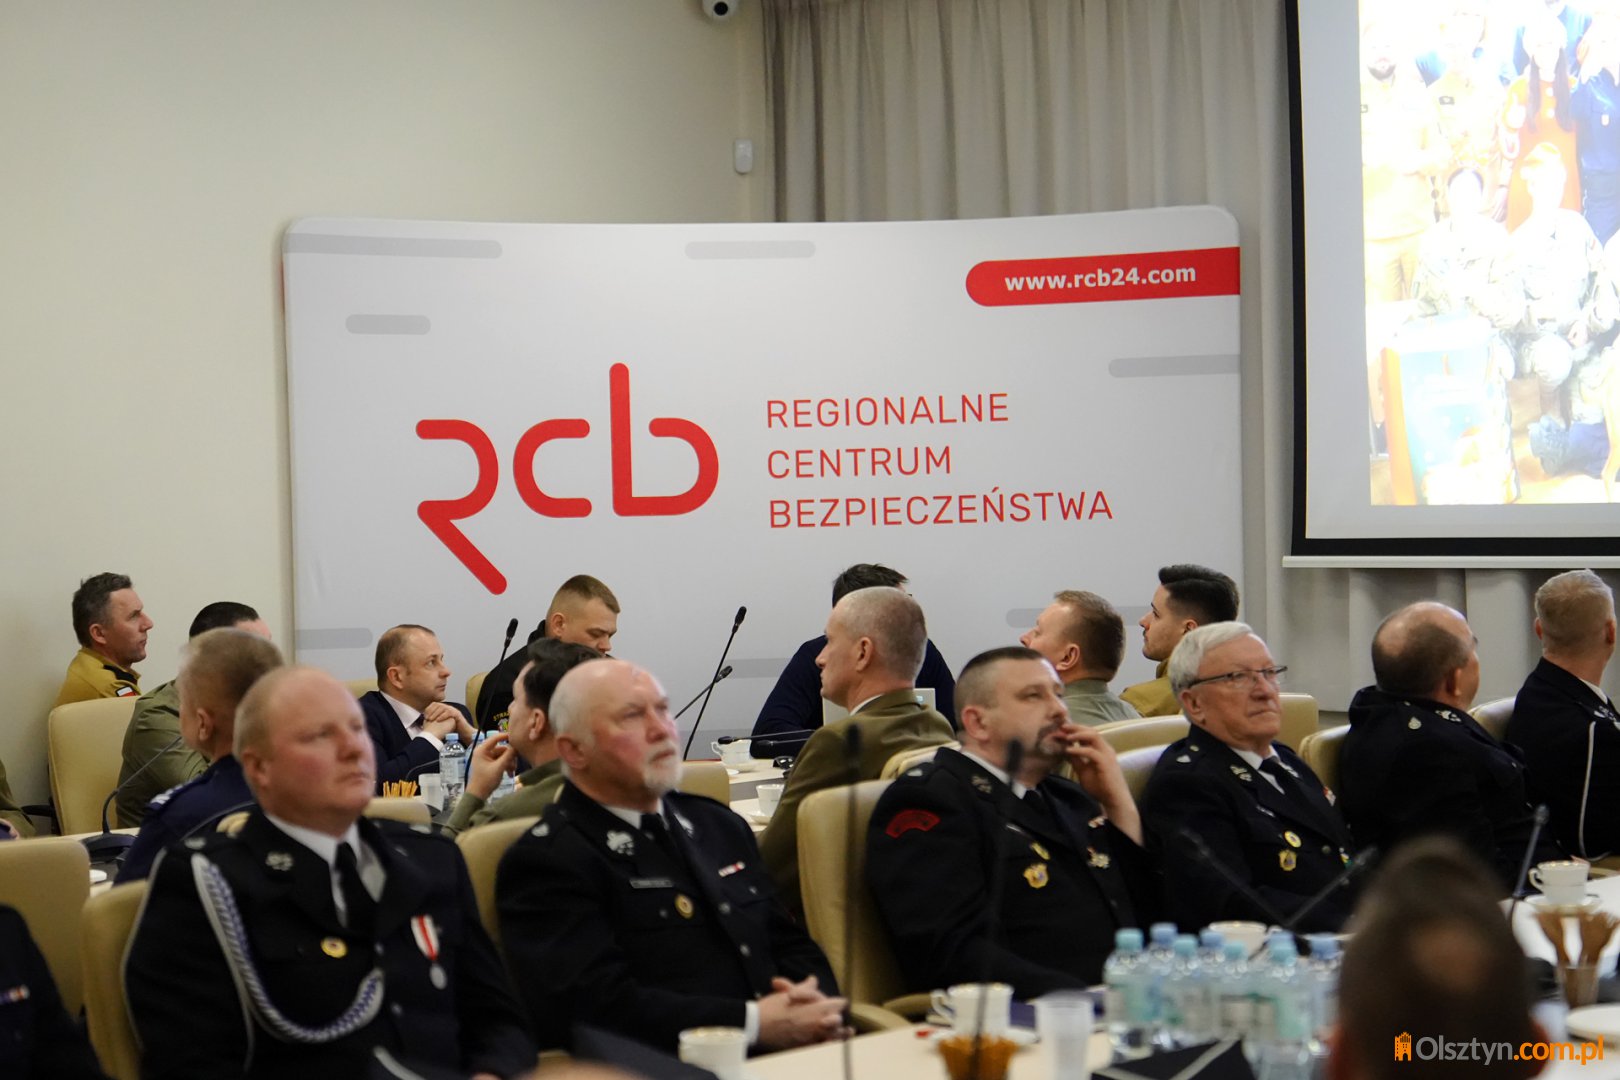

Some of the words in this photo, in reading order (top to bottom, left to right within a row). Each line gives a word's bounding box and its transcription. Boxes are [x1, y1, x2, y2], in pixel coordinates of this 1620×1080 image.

[1005, 267, 1196, 291] www.rcb24.com
[767, 393, 1008, 428] REGIONALNE
[767, 445, 950, 479] CENTRUM
[769, 486, 1113, 528] BEZPIECZEŃSTWA
